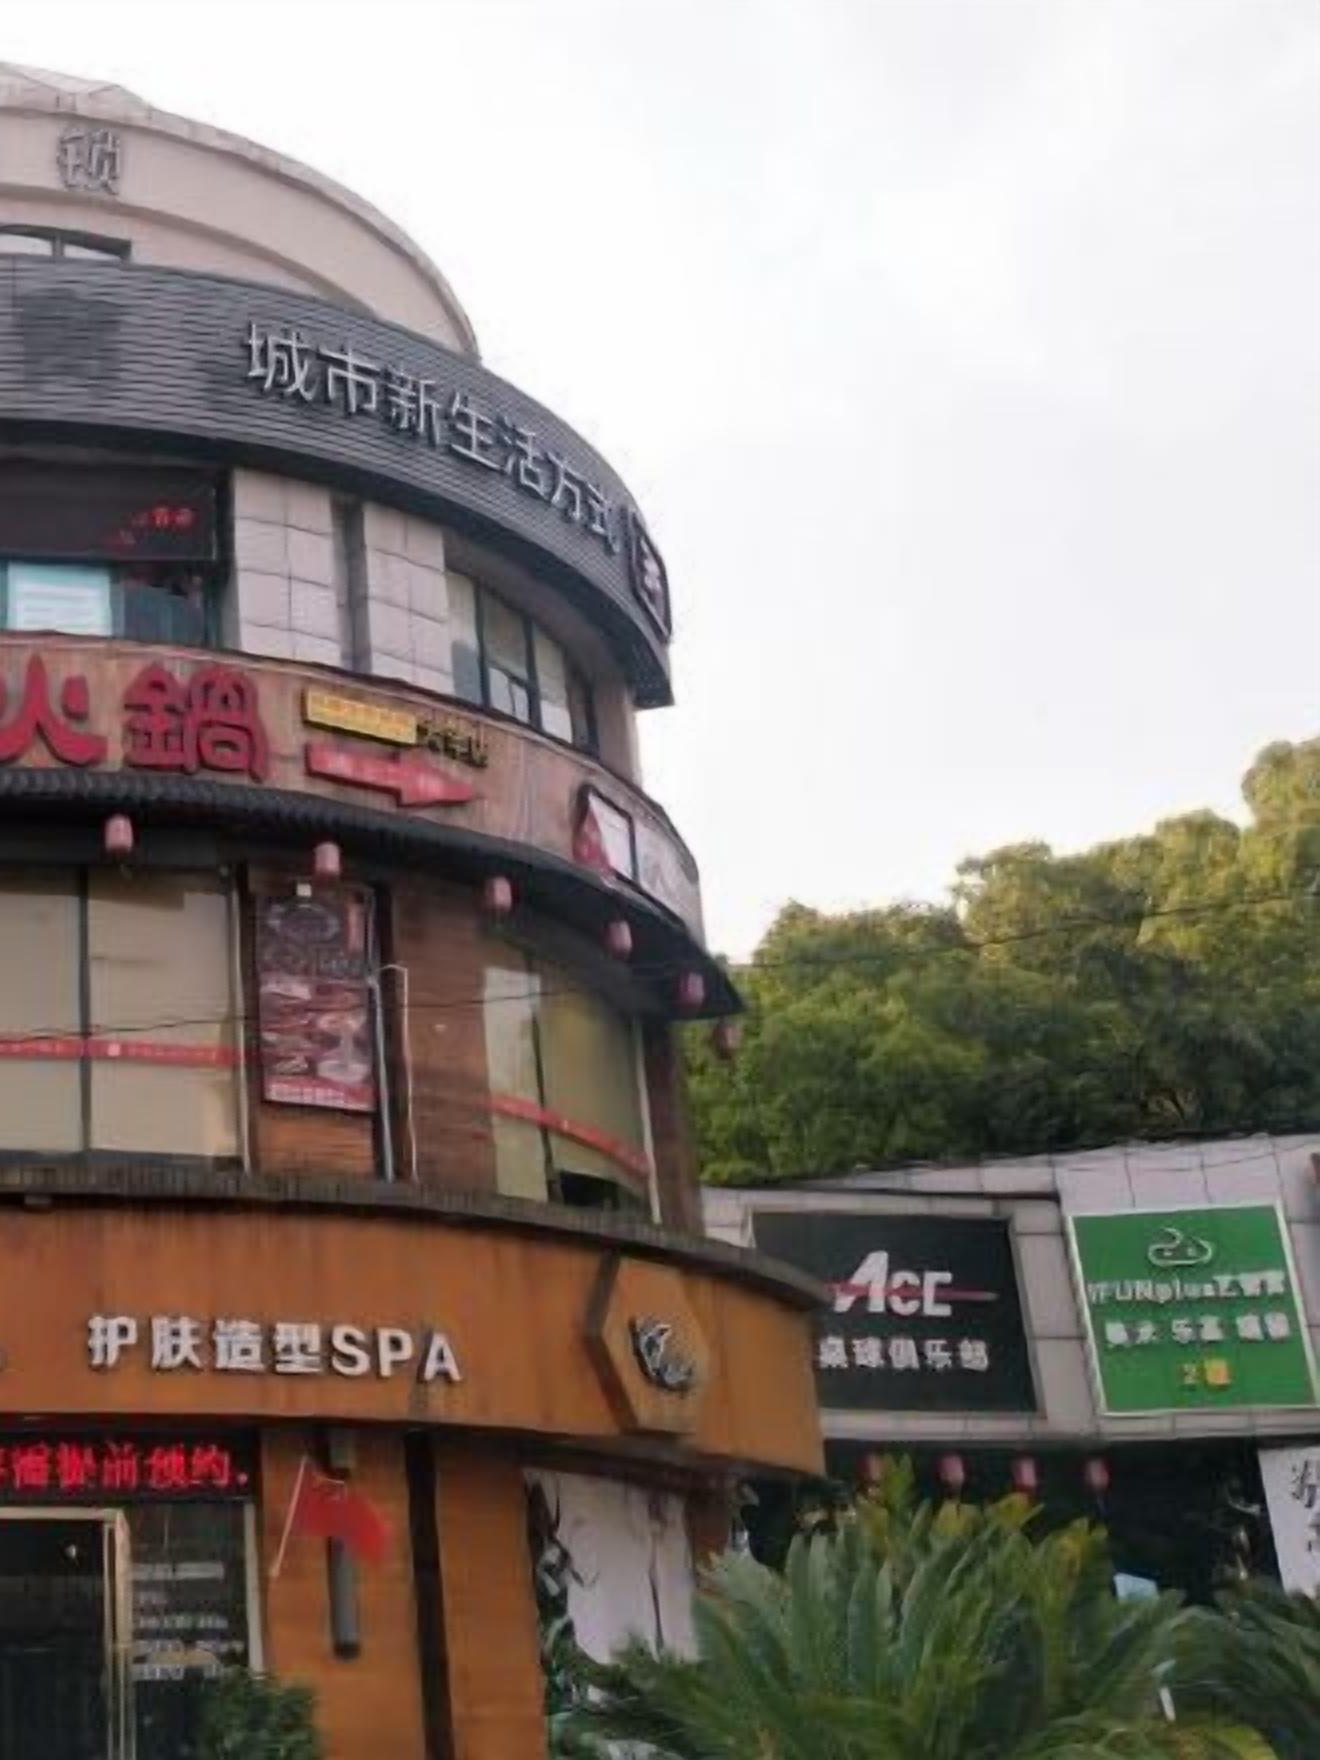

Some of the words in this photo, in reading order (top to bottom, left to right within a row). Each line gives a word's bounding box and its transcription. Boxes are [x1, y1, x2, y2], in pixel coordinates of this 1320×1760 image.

[242, 320, 622, 556] 城市新生活方式
